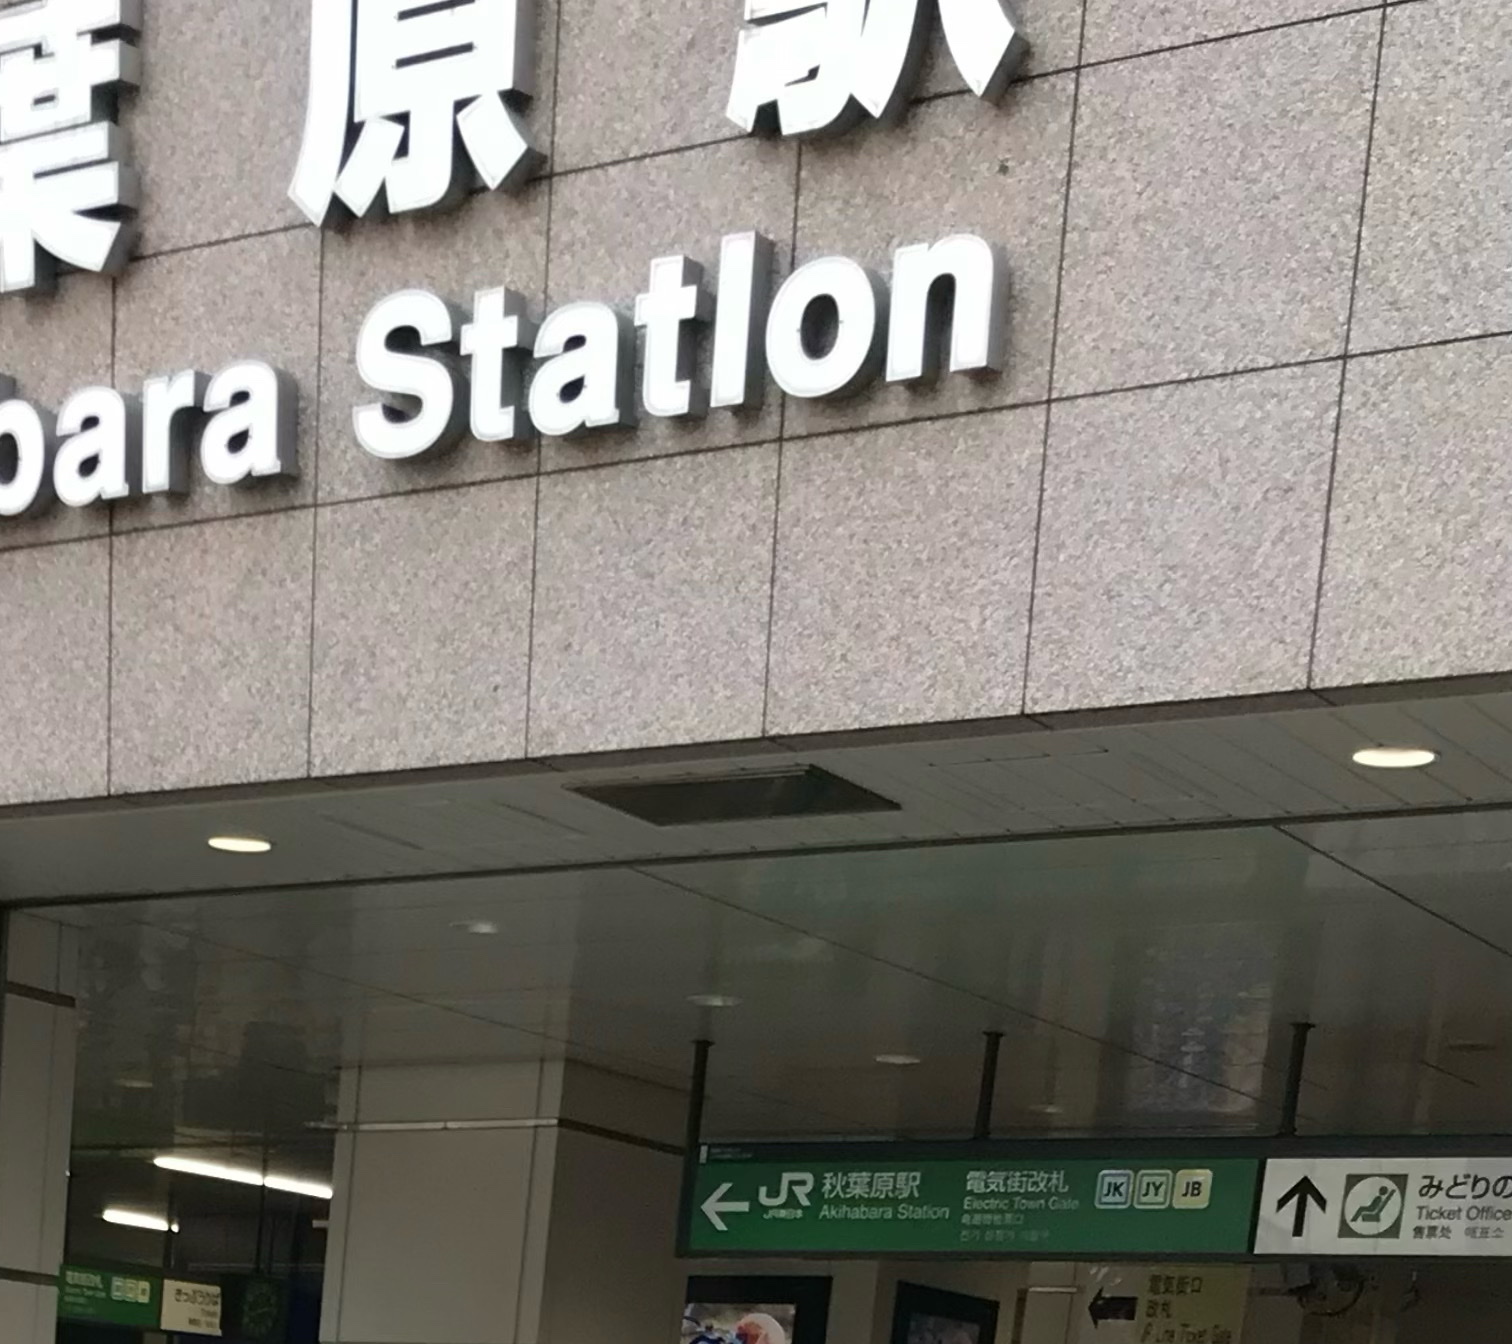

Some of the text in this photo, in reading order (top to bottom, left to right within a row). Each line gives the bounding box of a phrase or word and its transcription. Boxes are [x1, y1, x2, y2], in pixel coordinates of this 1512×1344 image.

[353, 230, 996, 460] Station
[758, 1171, 814, 1207] JR
[821, 1171, 922, 1200] 秋葉原駅
[965, 1169, 1070, 1194] 電気街改札
[1103, 1180, 1203, 1198] JK JY JB
[1418, 1173, 1512, 1200] みどりの
[818, 1202, 951, 1220] Akihabara Station
[963, 1196, 1080, 1211] Electric Town Gate
[1416, 1205, 1512, 1221] Ticket Office
